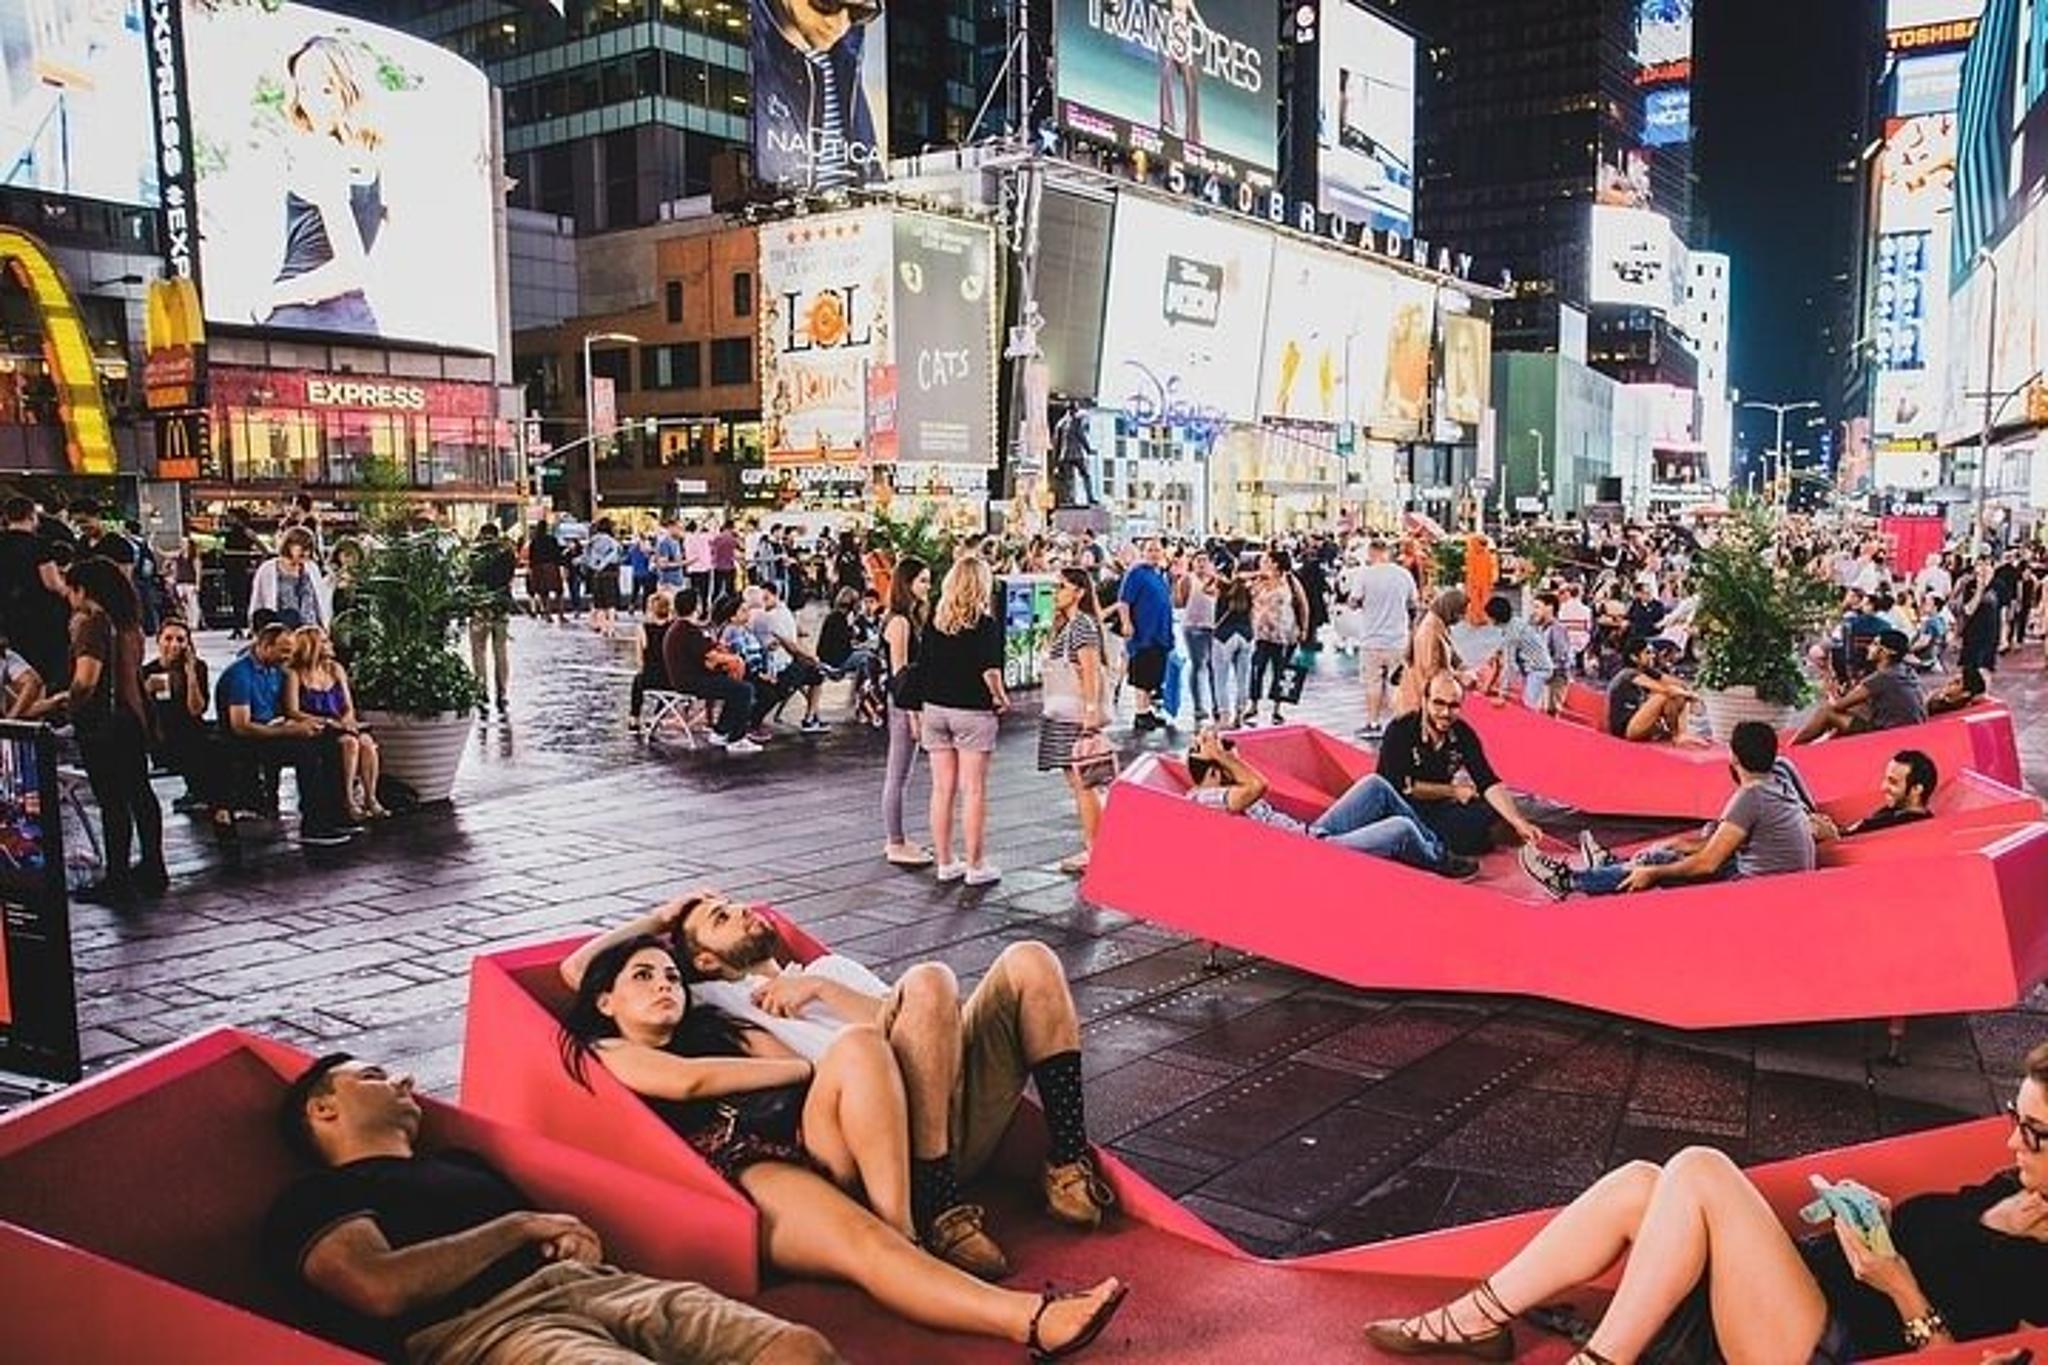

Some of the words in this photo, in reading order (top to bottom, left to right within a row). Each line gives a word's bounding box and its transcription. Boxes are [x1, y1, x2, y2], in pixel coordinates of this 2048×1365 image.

[151, 0, 183, 178] XPRESS
[767, 129, 884, 164] NAUTICA
[782, 284, 872, 354] LOL
[917, 350, 970, 391] CATS
[306, 380, 425, 410] EXPRESS
